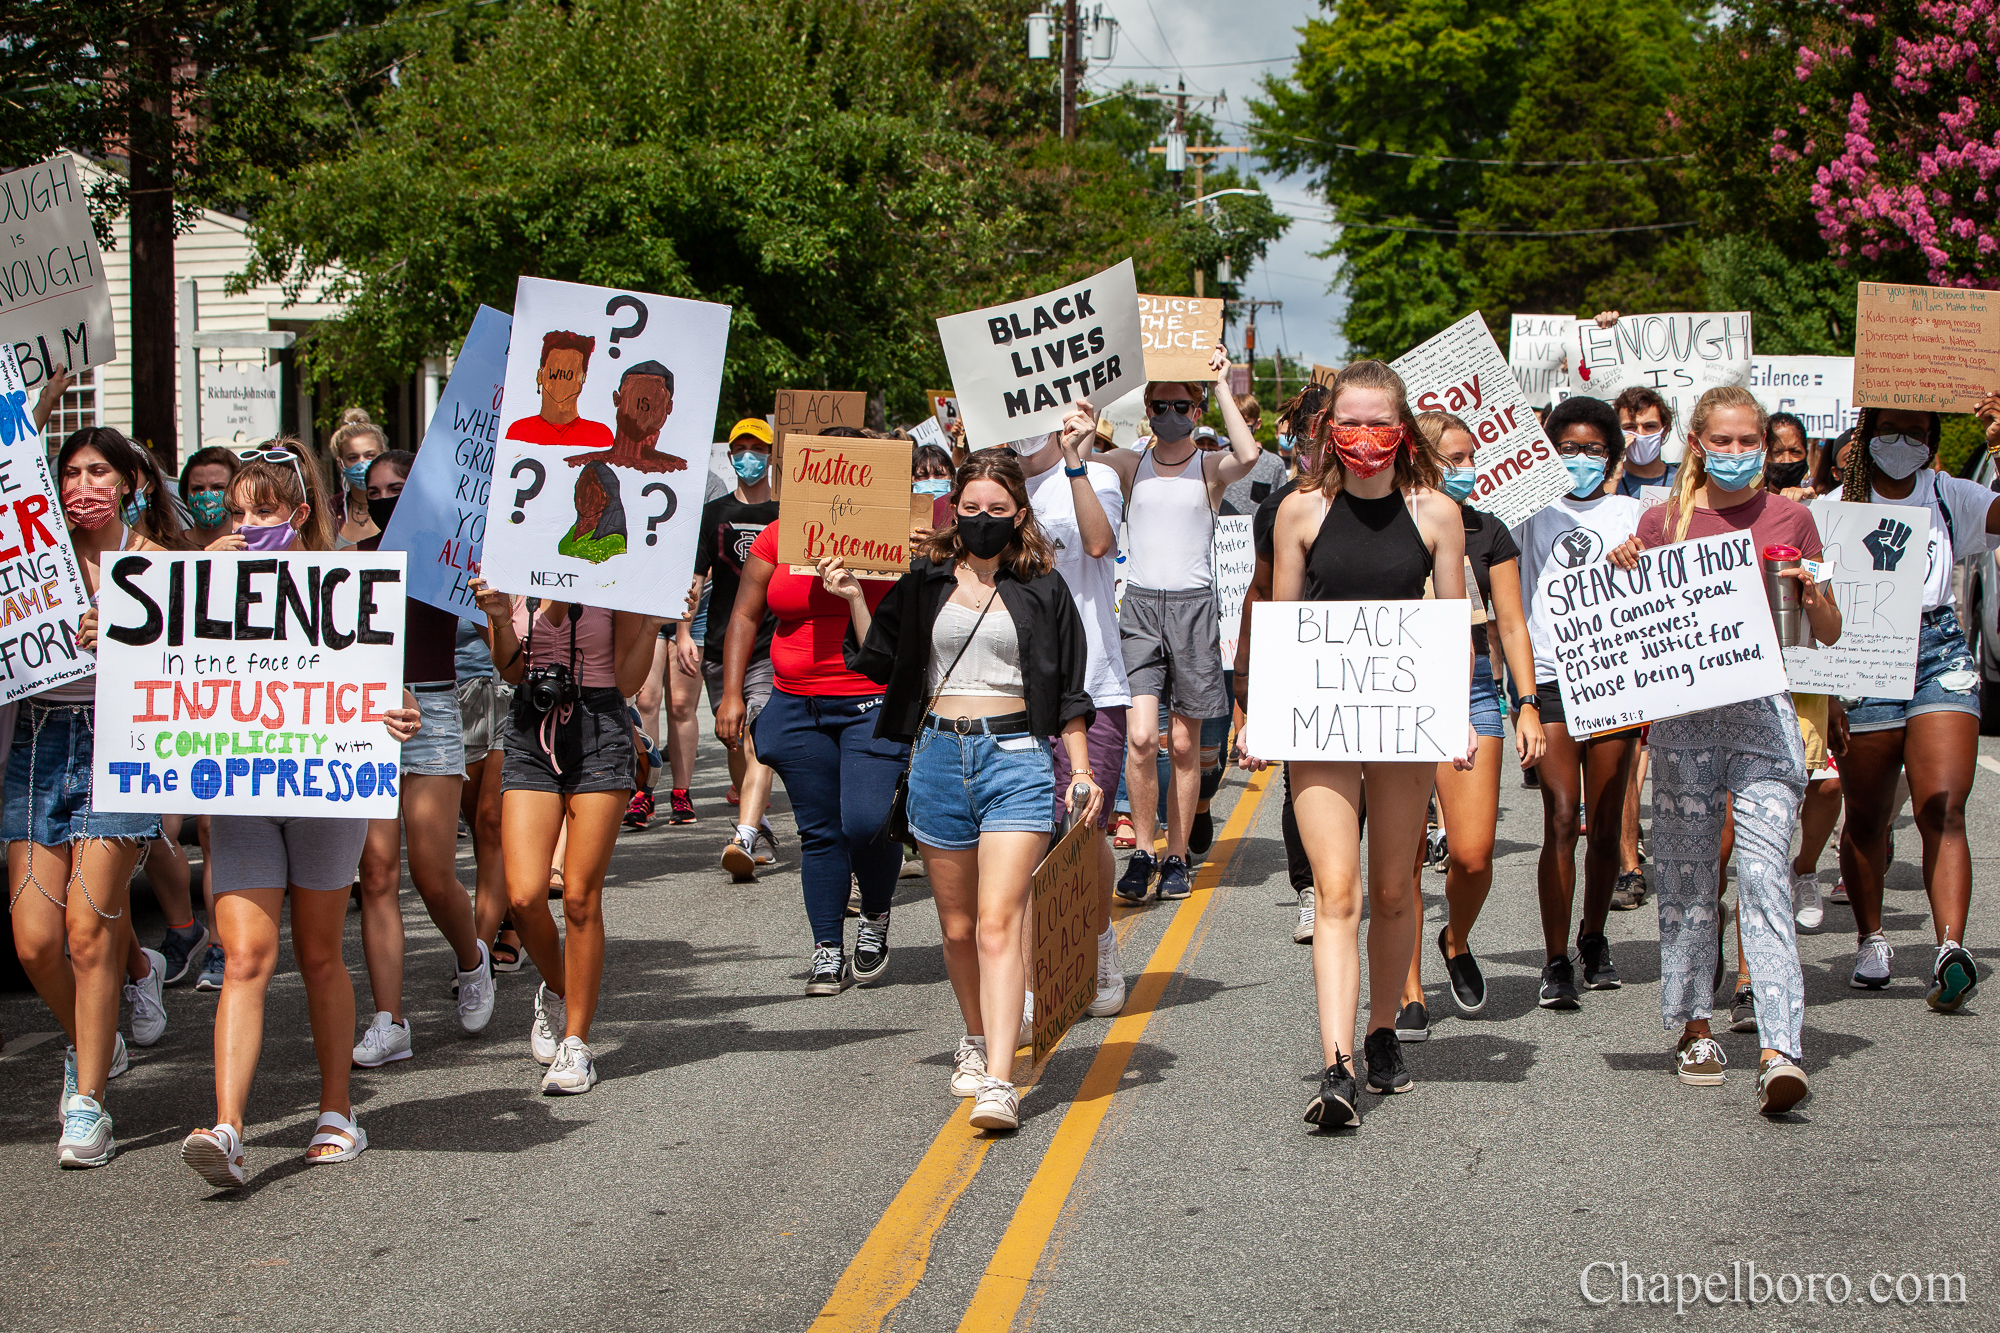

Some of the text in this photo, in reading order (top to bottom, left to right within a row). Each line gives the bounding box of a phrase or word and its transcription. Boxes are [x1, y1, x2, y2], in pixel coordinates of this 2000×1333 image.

[0, 164, 73, 224] OUGH
[10, 233, 26, 249] IS
[0, 240, 94, 303] NOUGH
[1139, 297, 1202, 315] OLICE
[1861, 283, 1880, 296] If
[1887, 286, 1905, 302] you
[1908, 286, 1928, 302] truly
[1968, 291, 1986, 301] that
[1911, 298, 1988, 313] All Lives Matter then
[987, 288, 1096, 346] BLACK
[1141, 314, 1183, 331] THE
[1866, 310, 1885, 323] Kids
[1889, 314, 1897, 323] in
[1900, 316, 1923, 326] cages
[1931, 318, 1952, 329] going
[1953, 320, 1981, 332] missing
[13, 321, 89, 388] BLM
[1010, 325, 1105, 379] LIVES
[1142, 330, 1211, 351] OLICE
[1515, 341, 1568, 363] LIVES
[1579, 315, 1749, 369] ENOUGH
[1865, 330, 1976, 348] Disrespect towards Natives
[1865, 348, 1987, 367] the innocent being murder by cops
[1914, 366, 1948, 376] starvation
[549, 367, 574, 383] WHO
[1002, 354, 1122, 419] MATTER
[1581, 366, 1622, 393] BLACK LIVES
[1600, 374, 1624, 392] MATTER
[1643, 368, 1694, 389] IS
[1750, 364, 1809, 387] Silence
[1865, 379, 1891, 388] Black
[1894, 380, 1917, 391] people
[1919, 379, 1937, 391] facing
[1937, 381, 1953, 389] racial
[208, 386, 276, 400] Richards-Johnston
[635, 396, 650, 413] IS
[778, 392, 845, 426] BLACK
[1417, 373, 1485, 414] Say
[1858, 389, 1889, 404] Should
[1894, 393, 1936, 404] OUTRAGE
[1938, 395, 1956, 408] you!
[454, 402, 501, 443] WHE
[1471, 404, 1516, 451] eir
[793, 447, 874, 487] Justice
[456, 473, 492, 506] RIG
[455, 507, 487, 543] YO
[829, 494, 862, 525] for
[803, 520, 910, 565] Breonna
[1215, 519, 1251, 535] Matter
[0, 552, 59, 597] ING
[530, 570, 580, 588] NEXT
[1220, 562, 1255, 577] Matter
[1547, 538, 1753, 616] SPEAK UP for those
[0, 579, 62, 628] AME
[106, 555, 401, 650] SILENCE
[1297, 606, 1422, 649] BLACK
[1553, 613, 1602, 643] Who
[1556, 611, 1699, 662] for themselves;
[163, 651, 320, 675] In the face of
[1565, 620, 1745, 682] ensure justice for
[1316, 654, 1417, 693] LIVES
[1570, 674, 1625, 705] those
[1635, 664, 1695, 688] being
[132, 680, 388, 729] INJUSTICE
[1574, 709, 1645, 731] Proverbs 31:8
[130, 730, 373, 759] is COMPLICITY with
[1293, 703, 1446, 757] MATTER
[108, 757, 399, 801] The OPPRESSOR
[1034, 861, 1059, 901] help
[1037, 865, 1092, 949] LOCAL
[1034, 952, 1085, 1028] OWNED
[1033, 972, 1095, 1063] BUSINESSES!
